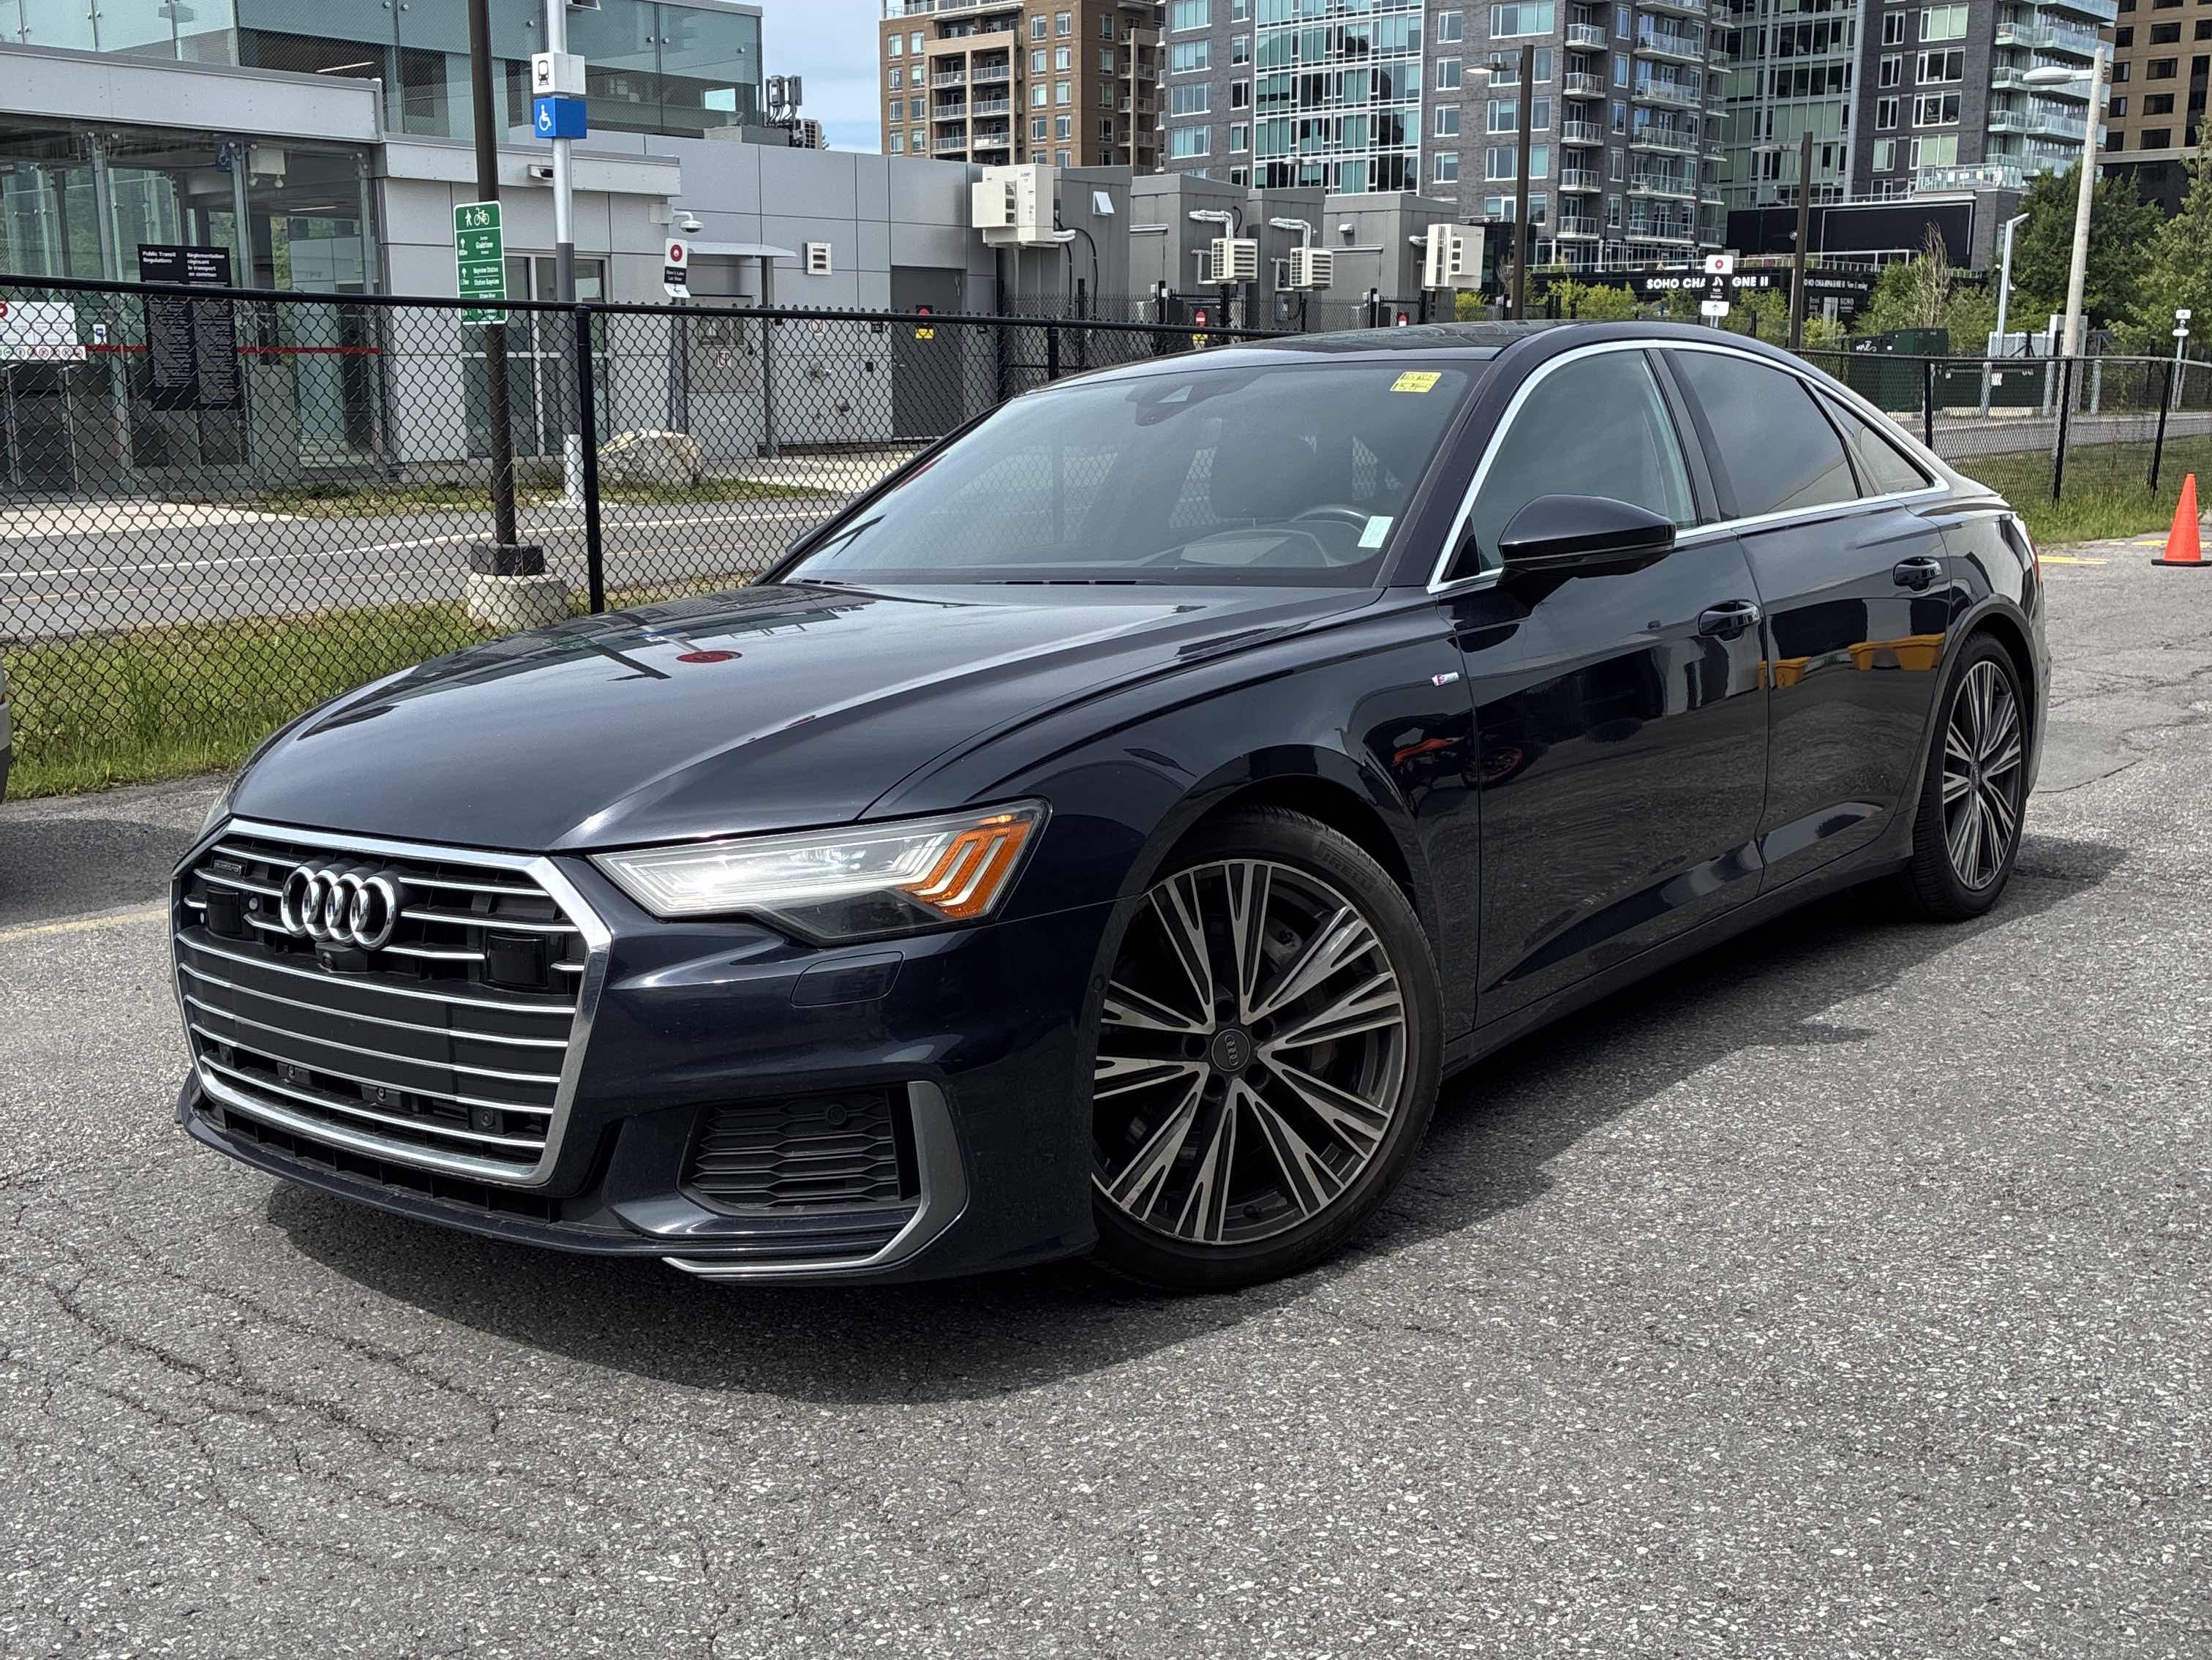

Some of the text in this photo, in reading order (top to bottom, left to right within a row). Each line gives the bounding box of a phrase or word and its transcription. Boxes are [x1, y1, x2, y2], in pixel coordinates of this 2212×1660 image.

[1647, 276, 1769, 289] SOHO CHAGNE II
